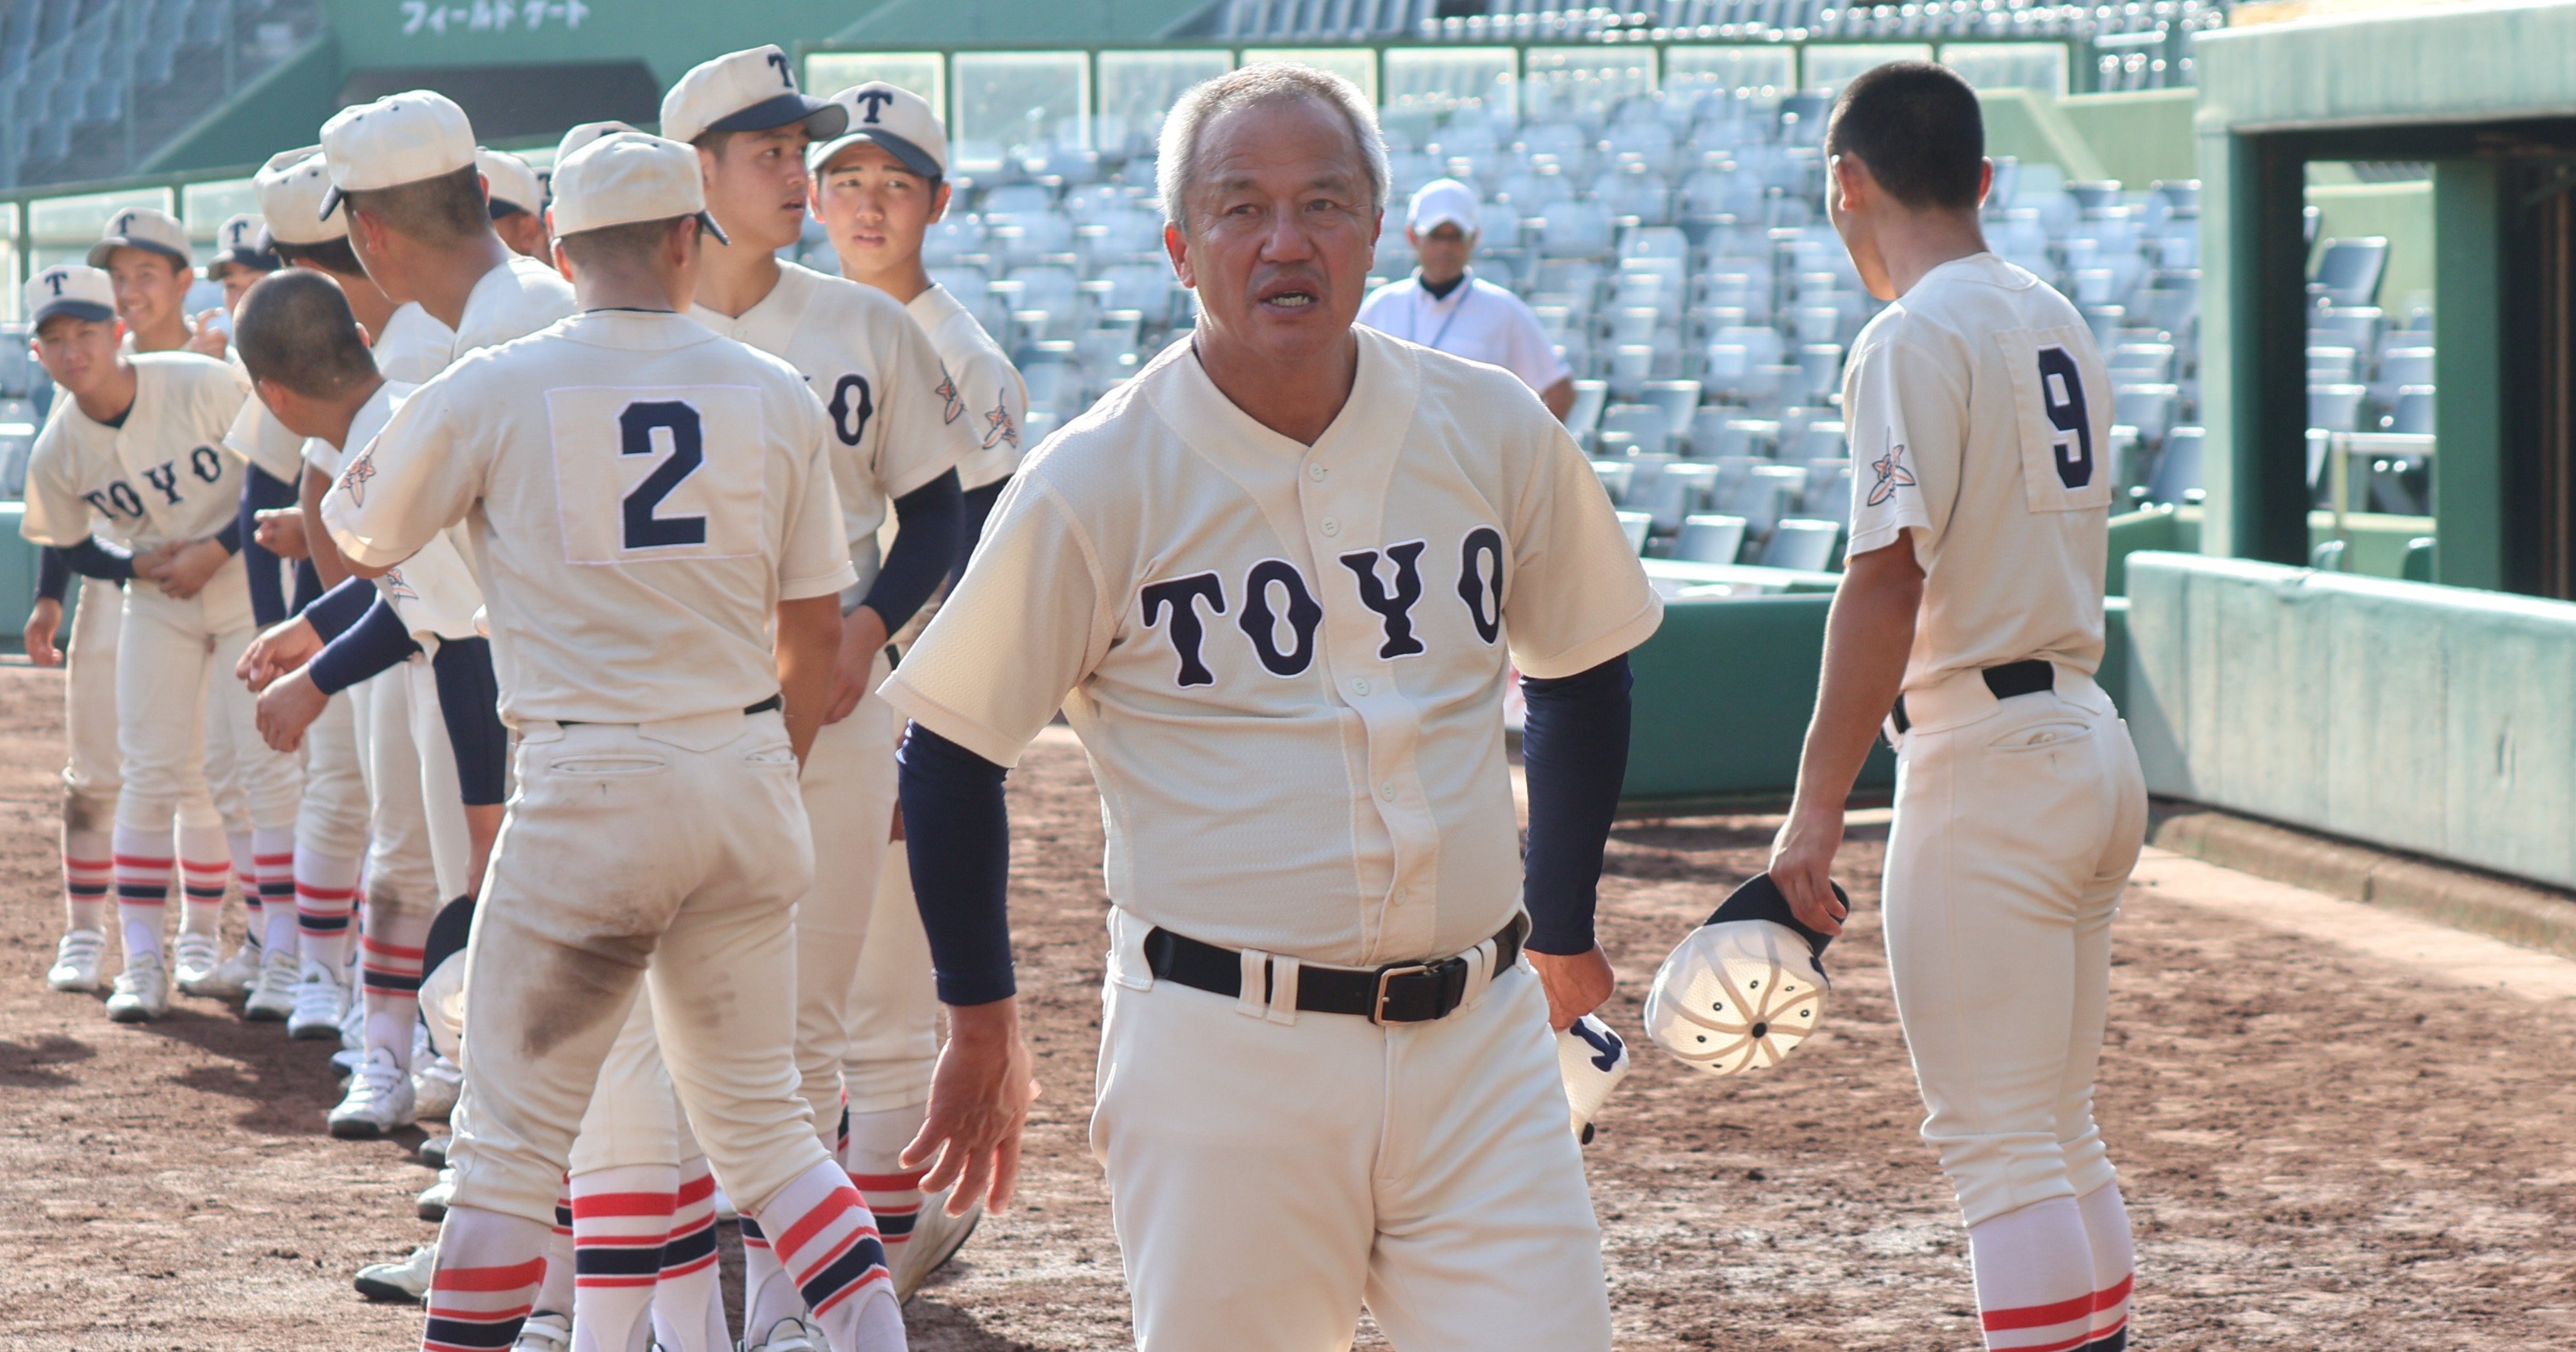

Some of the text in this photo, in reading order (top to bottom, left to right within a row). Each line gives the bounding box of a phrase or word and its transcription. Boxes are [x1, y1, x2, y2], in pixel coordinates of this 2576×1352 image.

[767, 52, 792, 87] T
[858, 89, 892, 123] T
[118, 213, 135, 234] T
[228, 221, 247, 243] T
[45, 272, 68, 296] T
[2037, 343, 2093, 490] 9
[80, 446, 221, 519] TOYO
[618, 397, 708, 551] 2
[1138, 524, 1503, 689] TOYO
[1570, 1017, 1623, 1072] T
